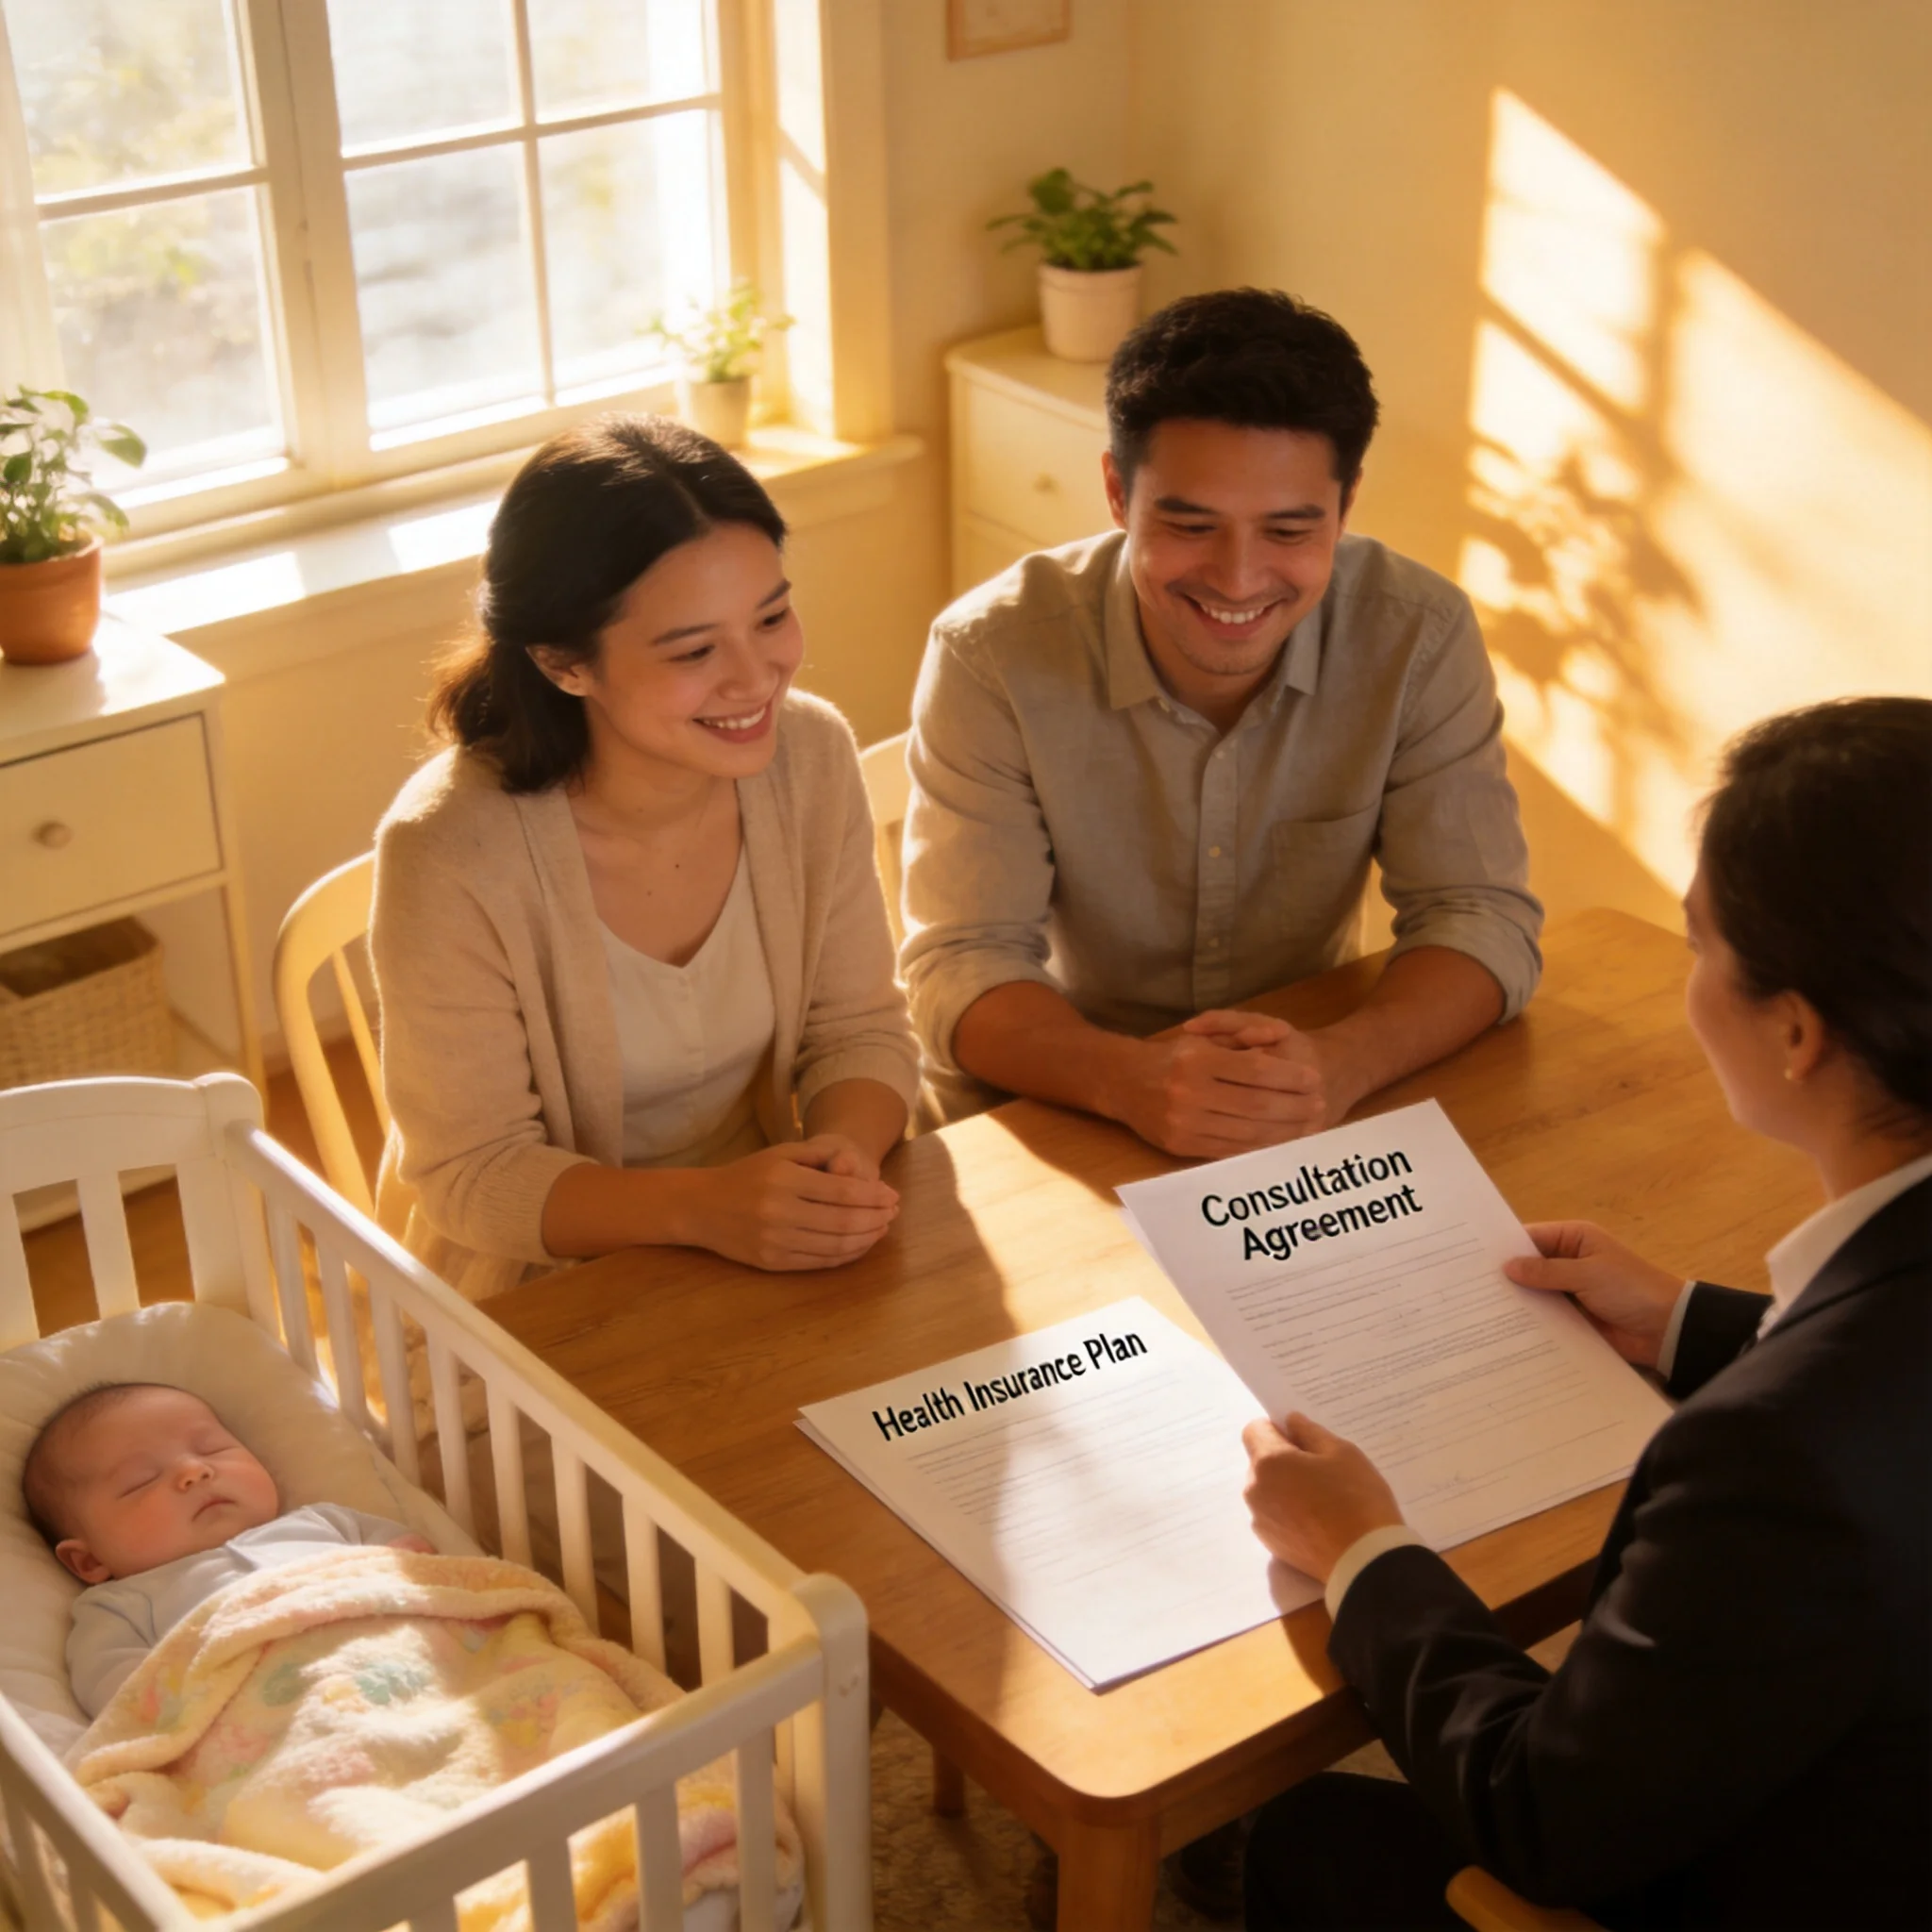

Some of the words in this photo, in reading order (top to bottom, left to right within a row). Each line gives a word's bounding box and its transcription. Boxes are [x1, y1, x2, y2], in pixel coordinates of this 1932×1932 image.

[1201, 1149, 1413, 1227] Consultation
[1242, 1183, 1424, 1262] Agreement
[872, 1387, 965, 1441] Health
[963, 1353, 1087, 1413] Insurance
[1083, 1332, 1148, 1370] Plan
